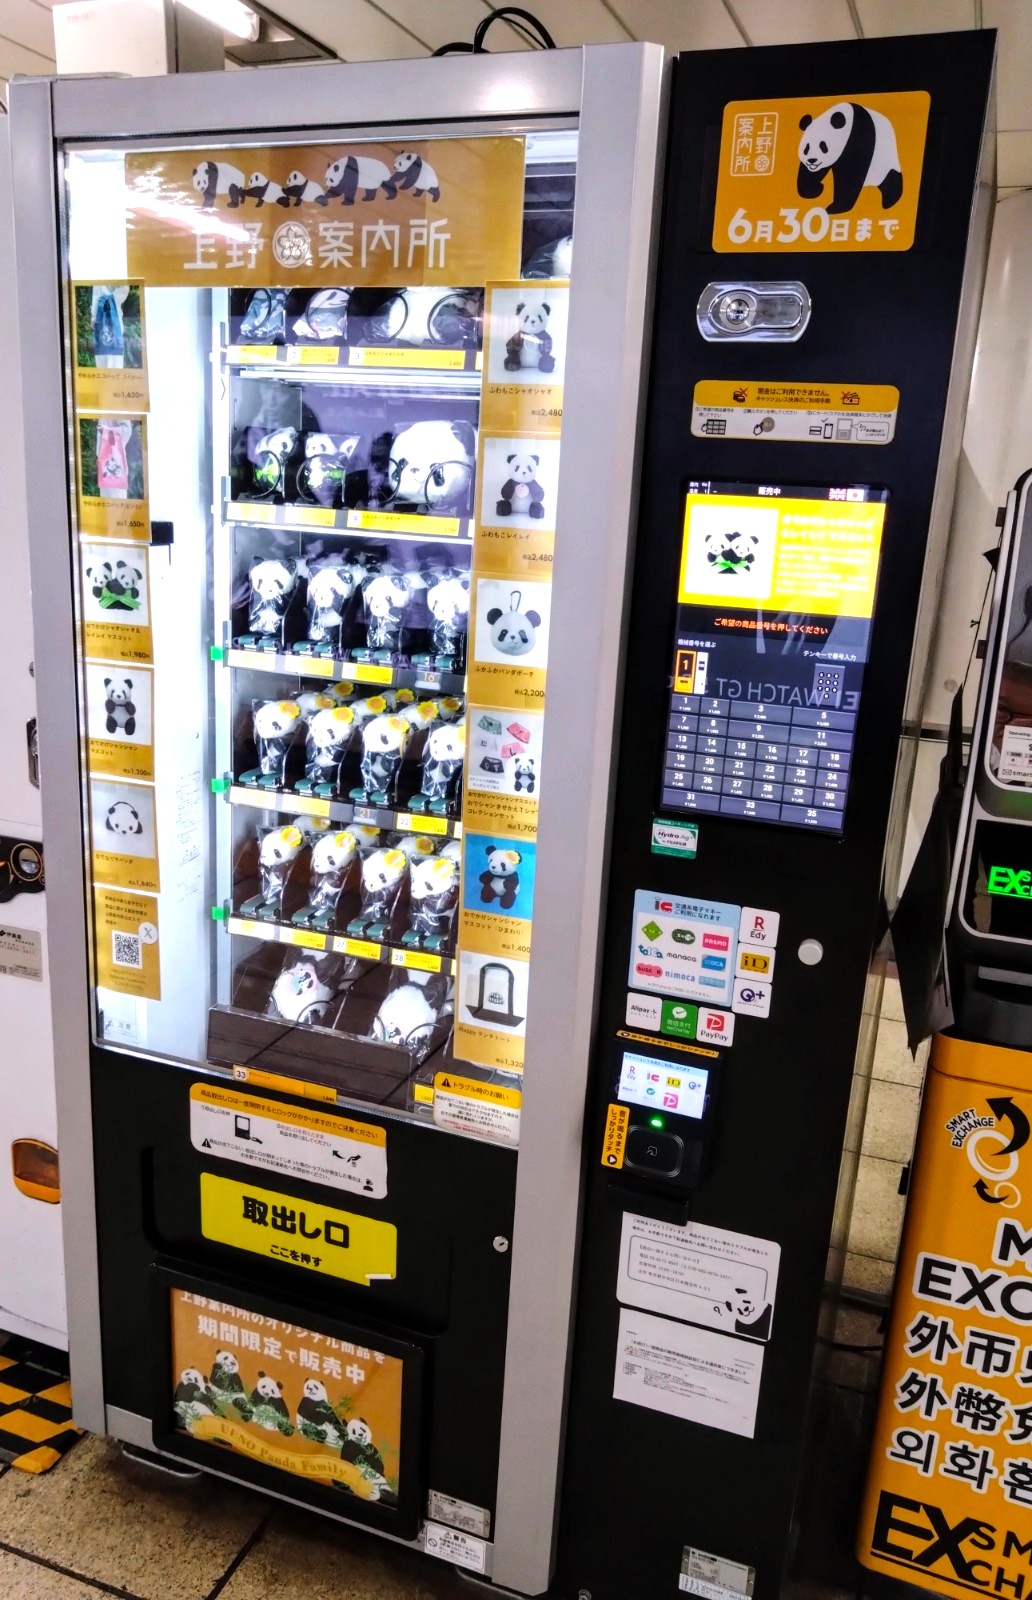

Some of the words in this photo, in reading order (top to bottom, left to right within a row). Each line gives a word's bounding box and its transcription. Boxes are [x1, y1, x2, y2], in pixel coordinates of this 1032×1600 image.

[755, 117, 773, 154] 上野
[734, 117, 755, 172] 案内所
[727, 206, 900, 244] 6月30日まで
[317, 217, 451, 269] 案内所
[489, 386, 553, 396] ふわもこシャオシャオ
[757, 387, 830, 397] 現金はご利用できません。
[758, 486, 781, 497] 販売中
[481, 530, 531, 541] ふわもこレイレイ
[714, 617, 828, 634] ご希望の商品番号を押してください
[803, 650, 857, 662] テンキーで番号入力
[475, 665, 535, 678] ふかふかパンダポーチ
[657, 831, 680, 839] Hydro
[675, 902, 722, 914] 交通系電子マネー
[464, 911, 522, 926] おでかけシャンシャン
[674, 910, 721, 922] ご利用になれます
[464, 920, 492, 930] マスコット
[750, 931, 766, 941] Edy
[394, 954, 404, 962] 28
[664, 970, 696, 982] nimoca
[701, 1030, 729, 1042] PayPay
[236, 1070, 246, 1079] 33
[453, 1081, 509, 1100] トラブル時のお願い
[946, 1108, 976, 1132] SMART
[606, 1108, 617, 1152] しっかりタッチ
[616, 1109, 626, 1155] 音が鳴るまで
[951, 1117, 995, 1148] EXCHANGE
[242, 1195, 350, 1249] 取出し口
[270, 1244, 323, 1267] ここを押す
[197, 1314, 366, 1386] 期間限定で販売中
[220, 1423, 257, 1450] UENO
[260, 1447, 296, 1470] Panda
[301, 1460, 348, 1479] Family
